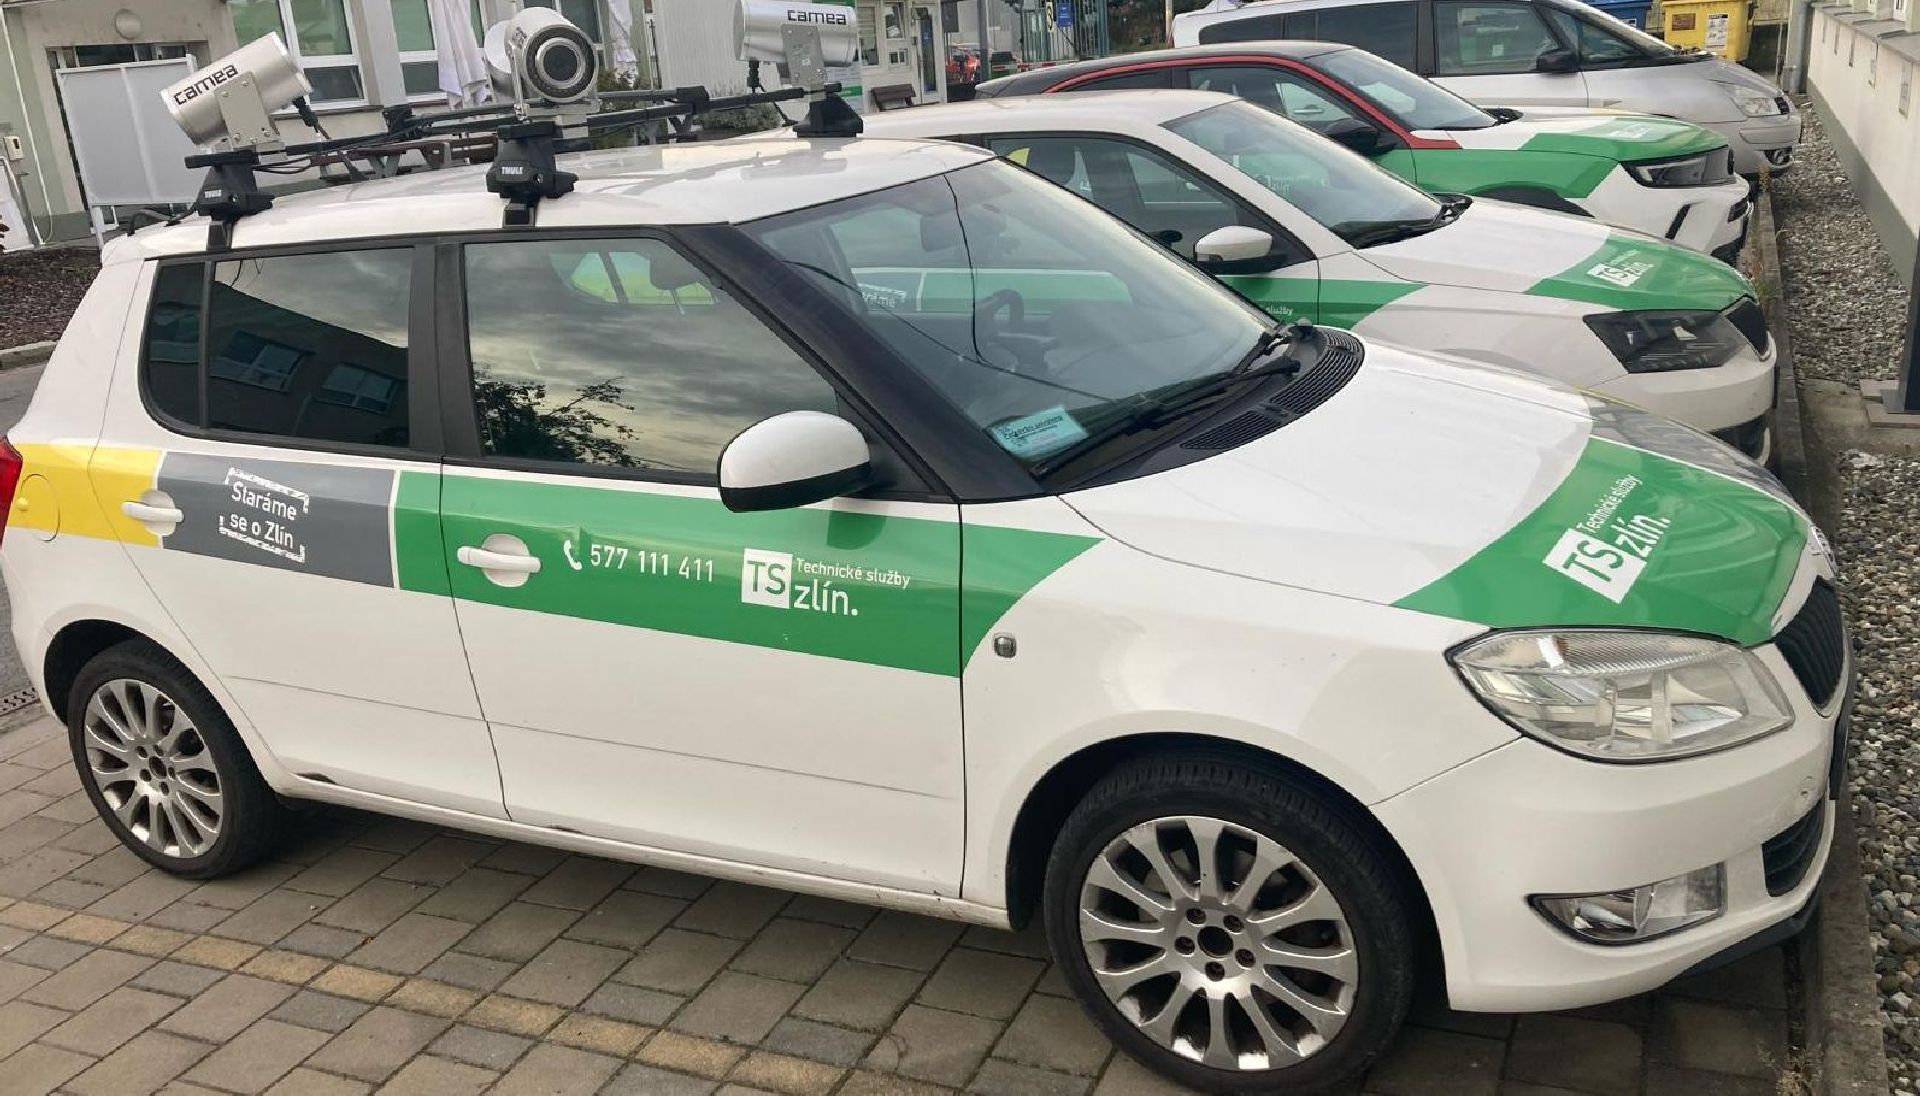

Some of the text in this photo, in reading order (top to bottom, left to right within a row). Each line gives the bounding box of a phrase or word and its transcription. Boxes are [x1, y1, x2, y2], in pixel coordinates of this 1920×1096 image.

[787, 9, 847, 26] camea
[173, 64, 238, 105] camea
[231, 480, 297, 521] Staráme
[1576, 493, 1622, 534] Technické
[230, 513, 294, 549] se o Zlín
[1611, 514, 1671, 557] zlín.
[590, 543, 713, 582] 577 111 411
[746, 560, 786, 595] TS
[796, 557, 911, 590] Technické služby
[1562, 540, 1625, 582] TS
[793, 578, 859, 616] zlín.
